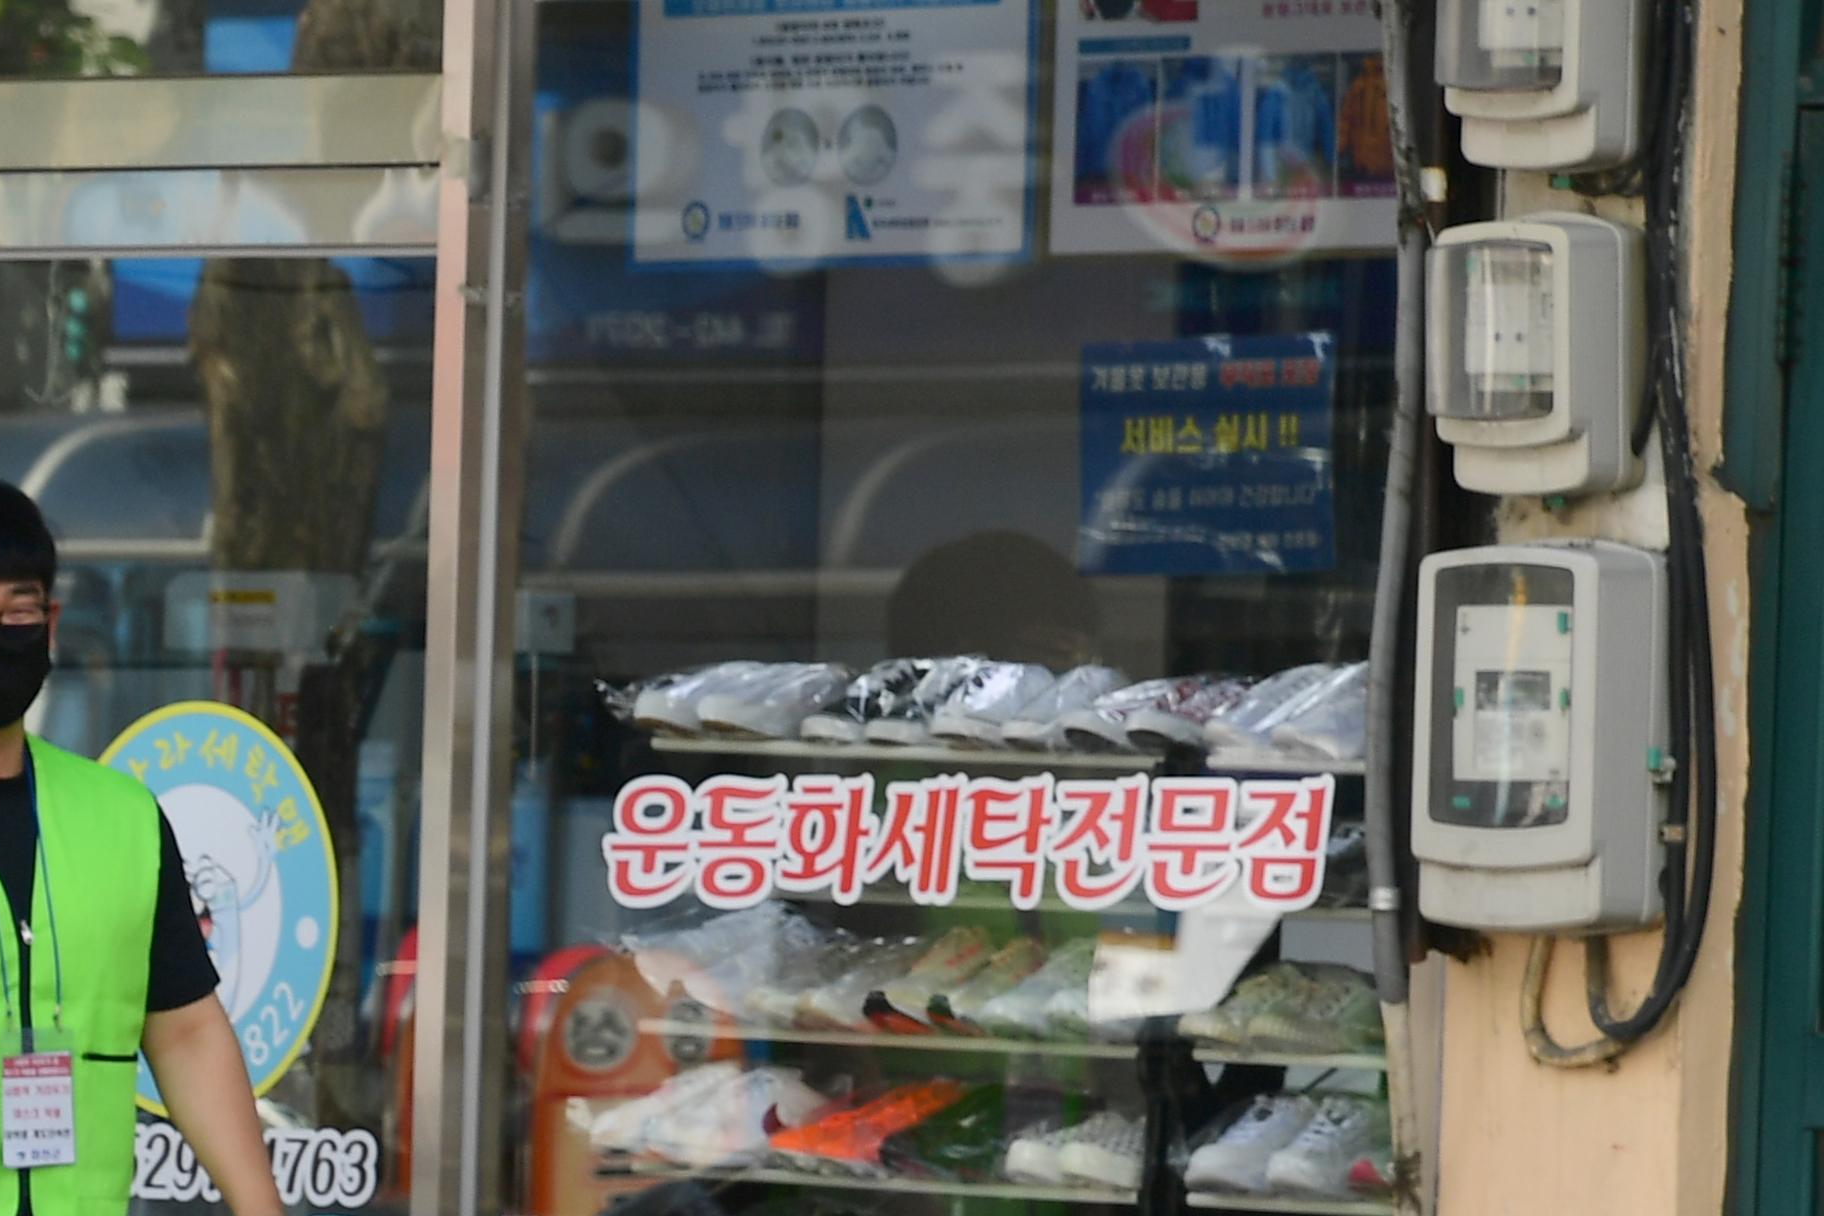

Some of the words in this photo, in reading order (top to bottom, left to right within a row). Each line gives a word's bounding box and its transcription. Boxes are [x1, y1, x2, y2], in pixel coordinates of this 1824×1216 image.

[1120, 414, 1204, 456] 서비스
[601, 769, 1336, 912] 운동화세탁전문점
[262, 1127, 379, 1209] 763
